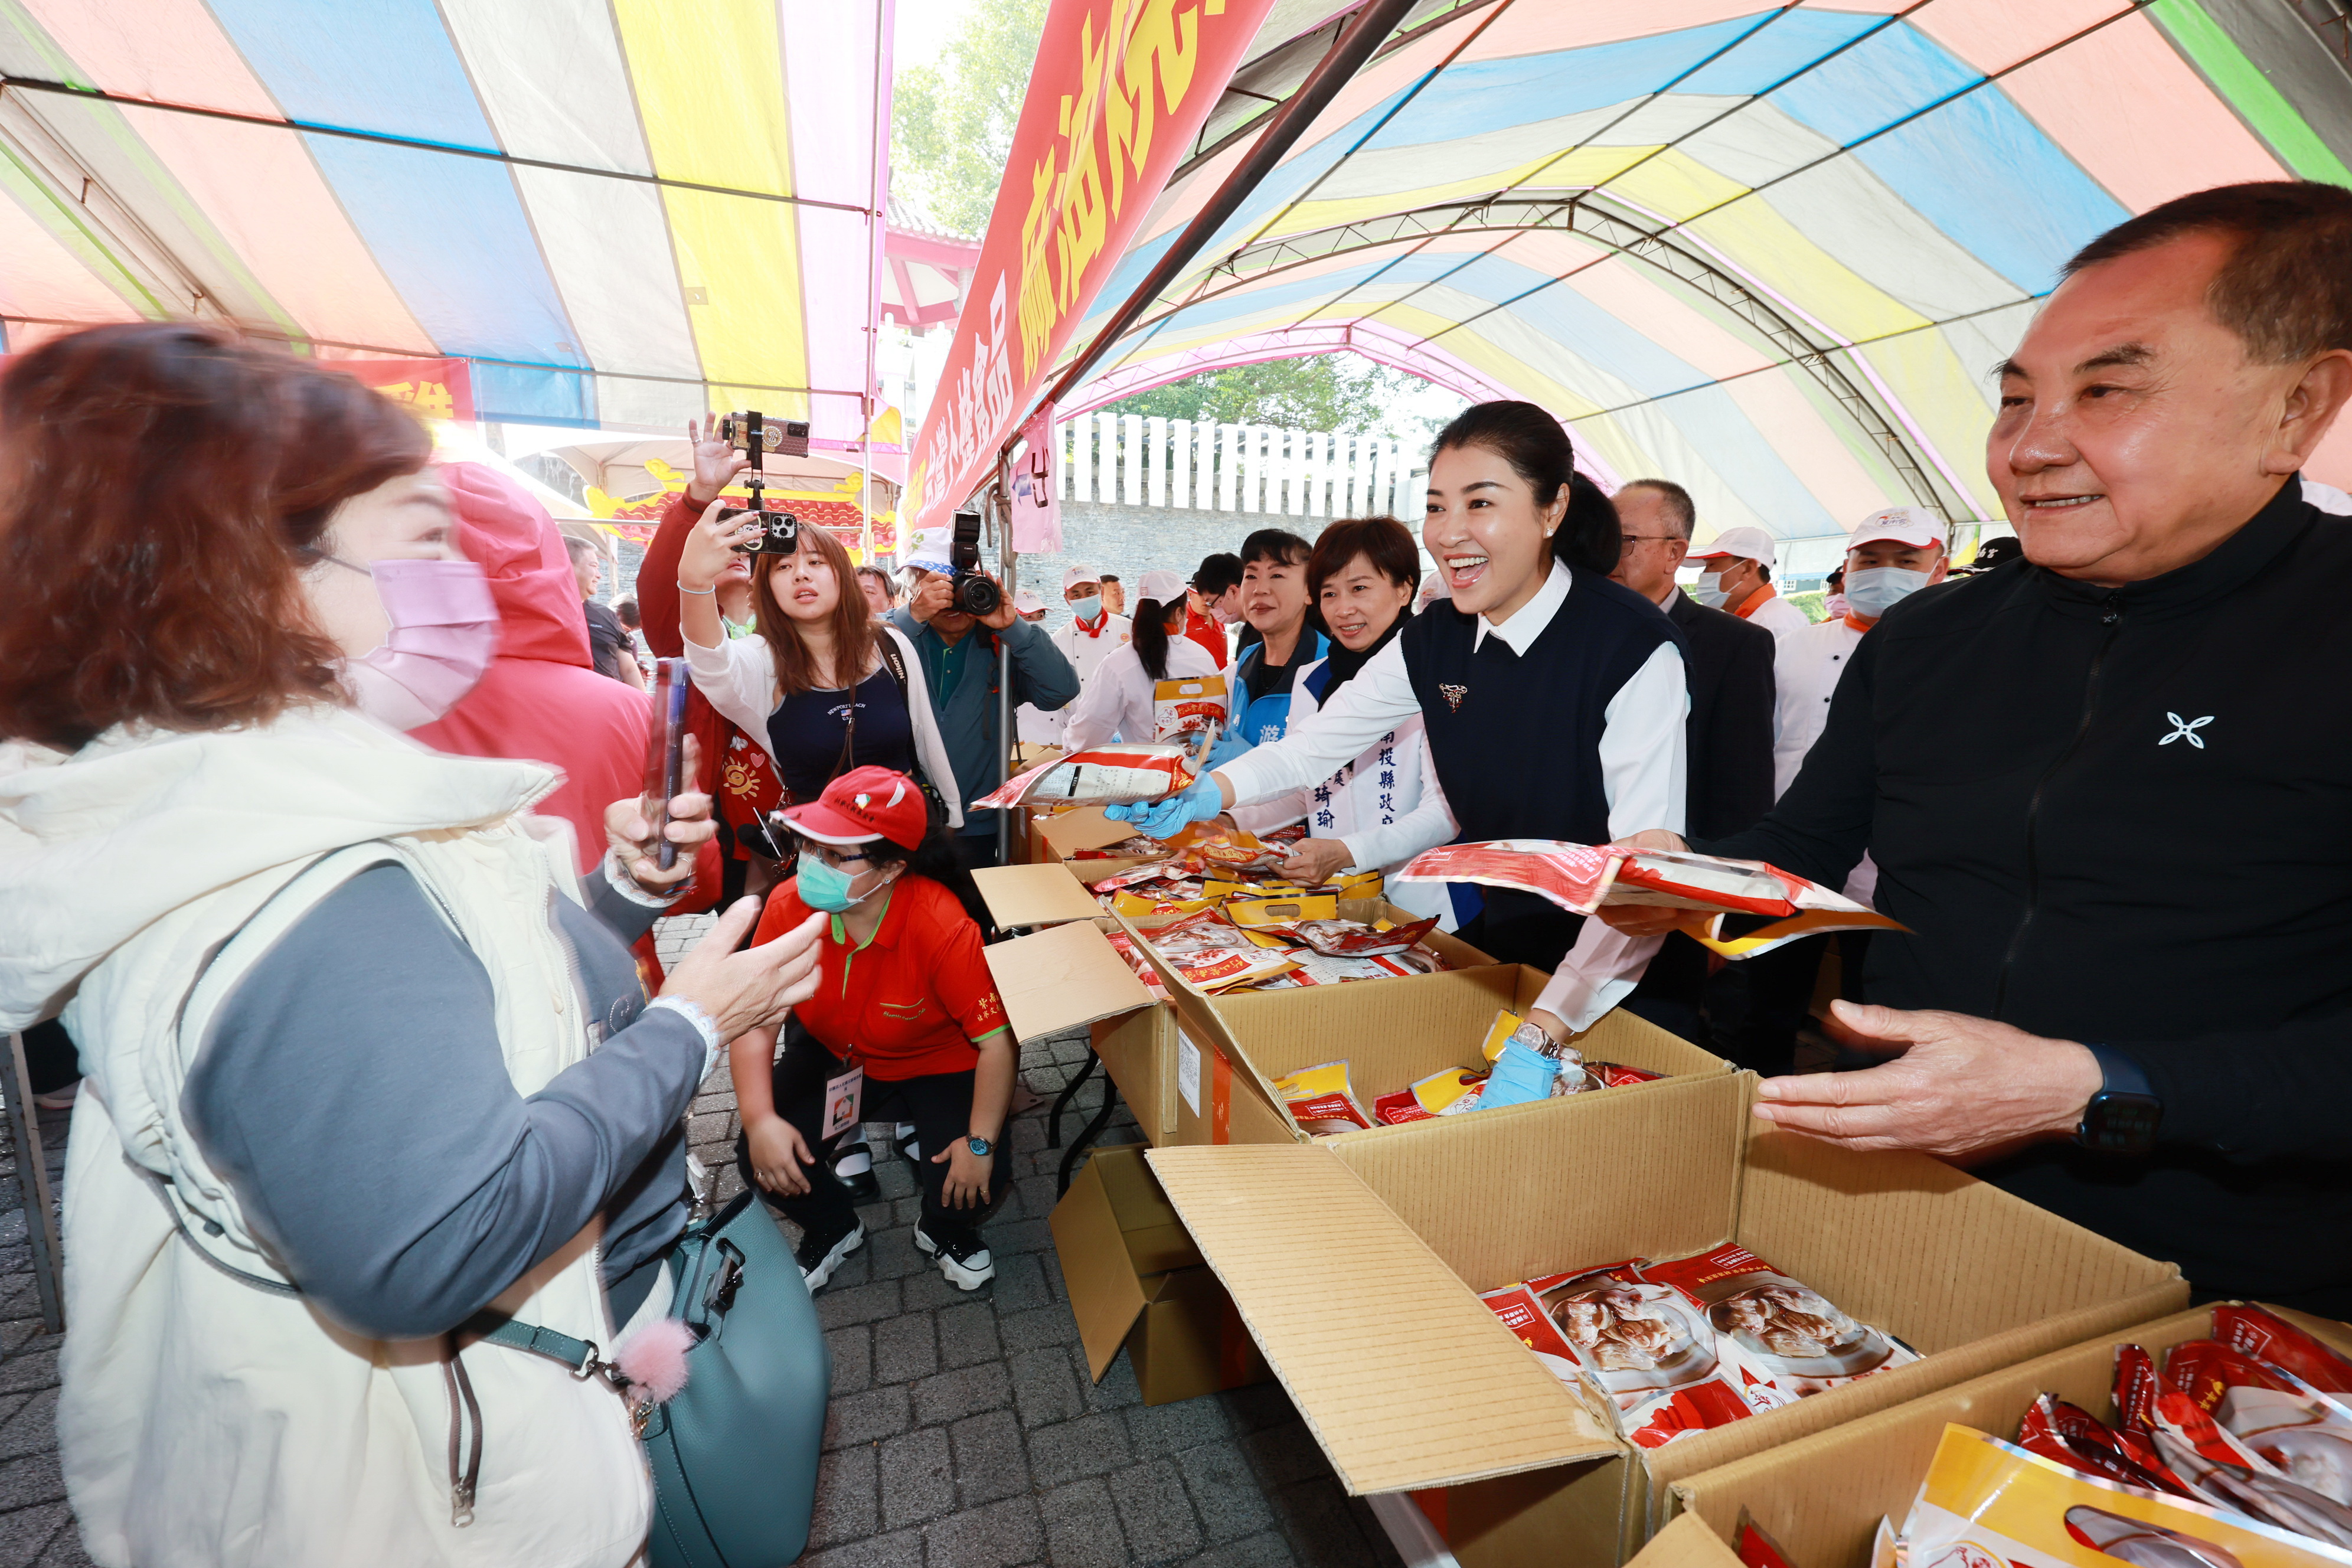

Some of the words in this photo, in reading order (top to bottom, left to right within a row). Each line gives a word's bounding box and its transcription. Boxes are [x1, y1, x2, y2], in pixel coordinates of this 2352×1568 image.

[890, 654, 905, 680] Nikon
[827, 704, 849, 716] NEWPORT
[1314, 777, 1335, 829] 琦瑜
